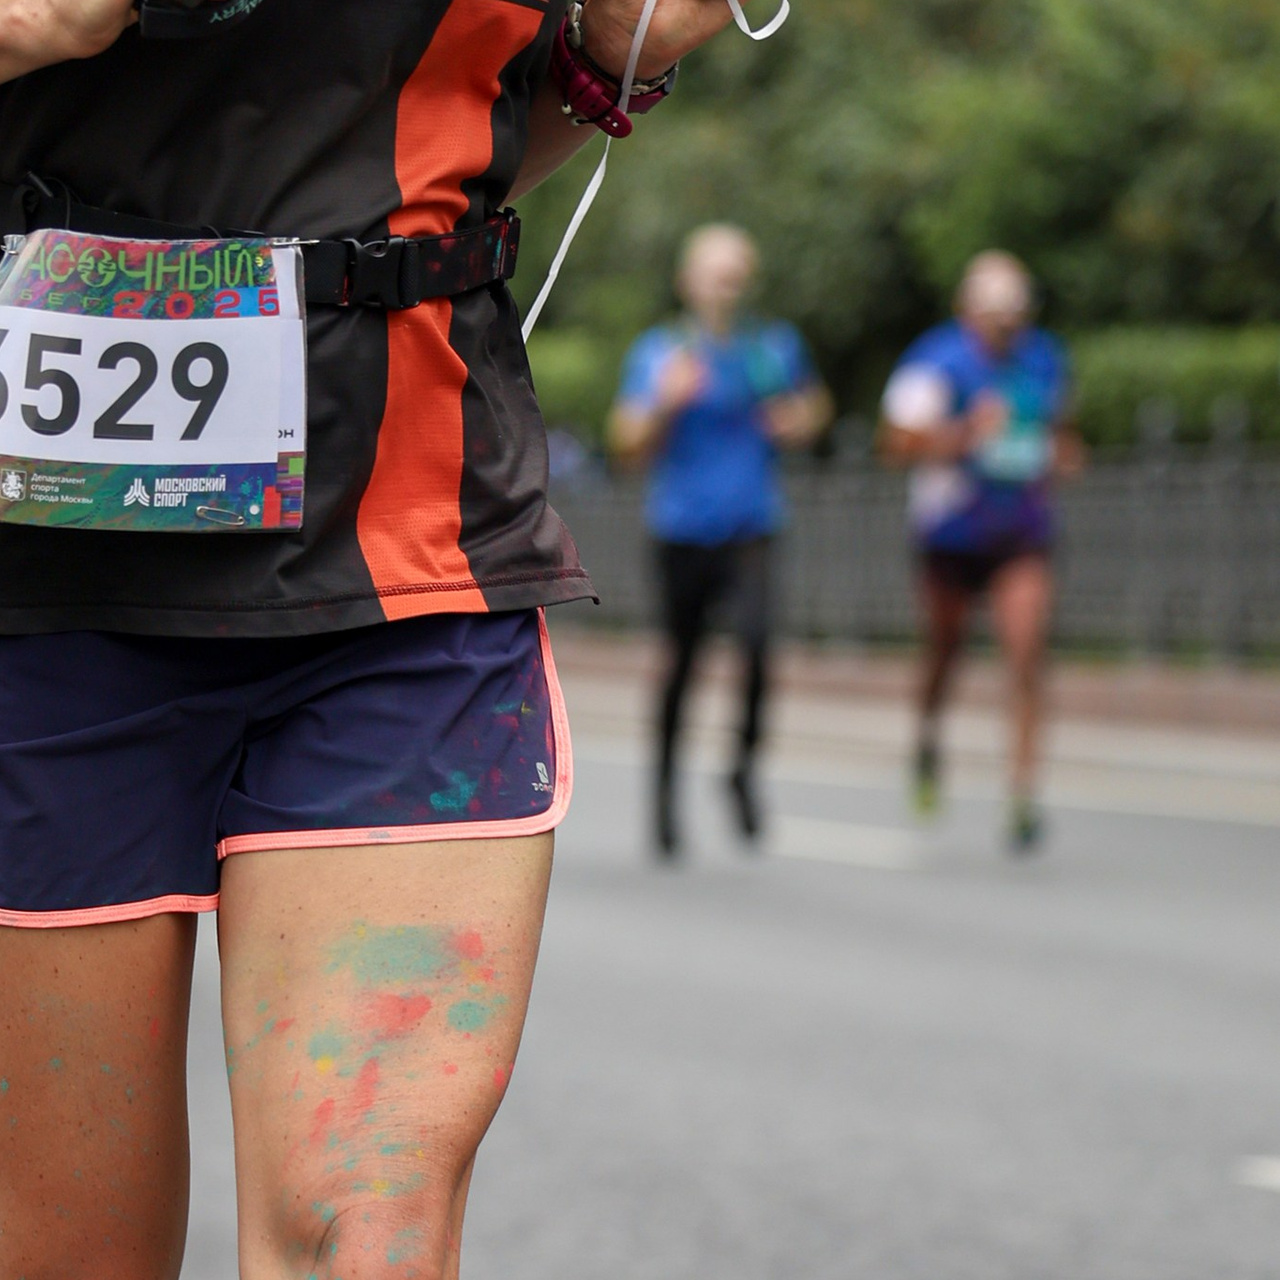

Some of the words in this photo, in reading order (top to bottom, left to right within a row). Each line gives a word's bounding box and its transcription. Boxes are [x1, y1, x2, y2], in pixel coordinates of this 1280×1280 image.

[113, 287, 280, 320] 2025
[30, 473, 87, 485] Департамент
[154, 474, 227, 493] МОСКОВСКИЙ
[30, 484, 60, 493] спорта
[29, 493, 60, 503] города
[60, 494, 94, 504] Москвы
[153, 493, 189, 507] СПОРТ
